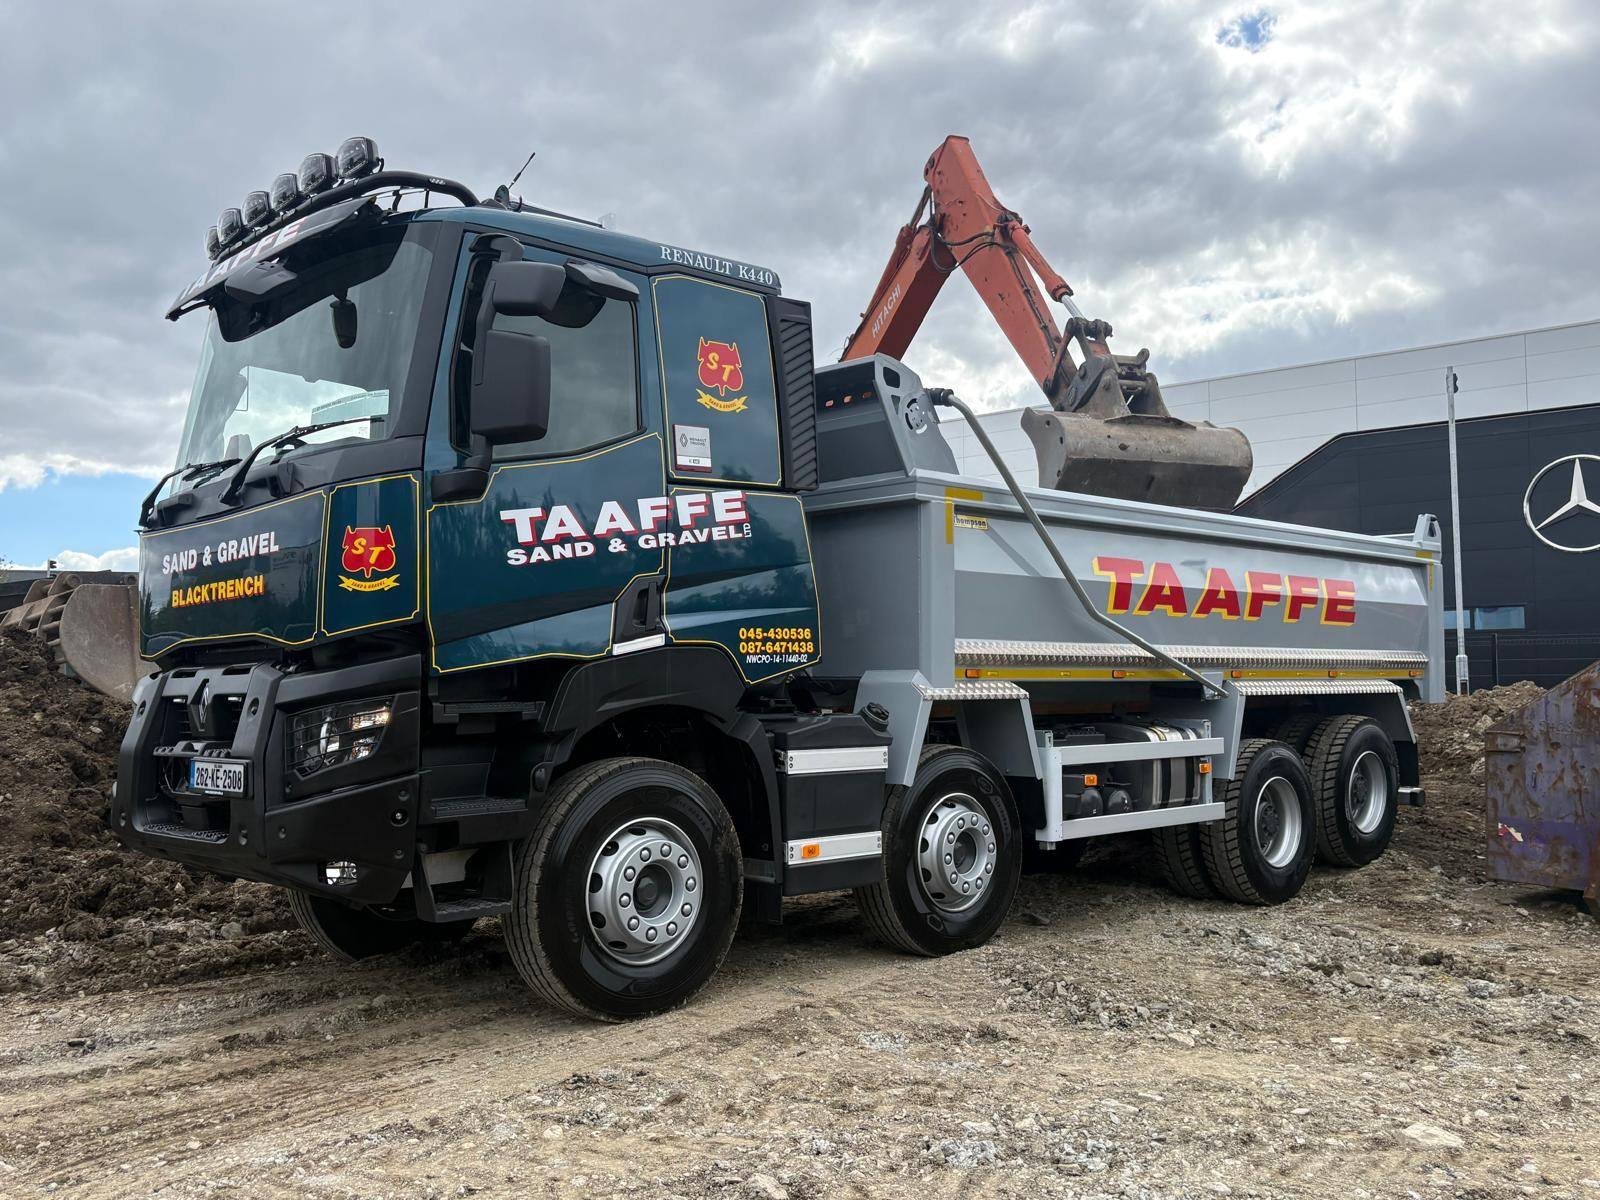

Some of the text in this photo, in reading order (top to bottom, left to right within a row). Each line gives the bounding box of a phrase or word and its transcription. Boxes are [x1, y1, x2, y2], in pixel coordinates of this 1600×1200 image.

[659, 245, 773, 285] RENAULT K440
[871, 283, 901, 339] HITACHI
[499, 490, 750, 545] TAAFFE
[162, 531, 280, 575] SAND & GRAVEL
[506, 522, 752, 567] SAND & GRAVEL LTD
[171, 574, 266, 609] BLACKTRENCH
[1092, 555, 1357, 626] TAAFFE
[739, 627, 812, 640] 045-430536
[739, 641, 814, 654] 087-6471438
[195, 768, 242, 790] 262-KE-2508
